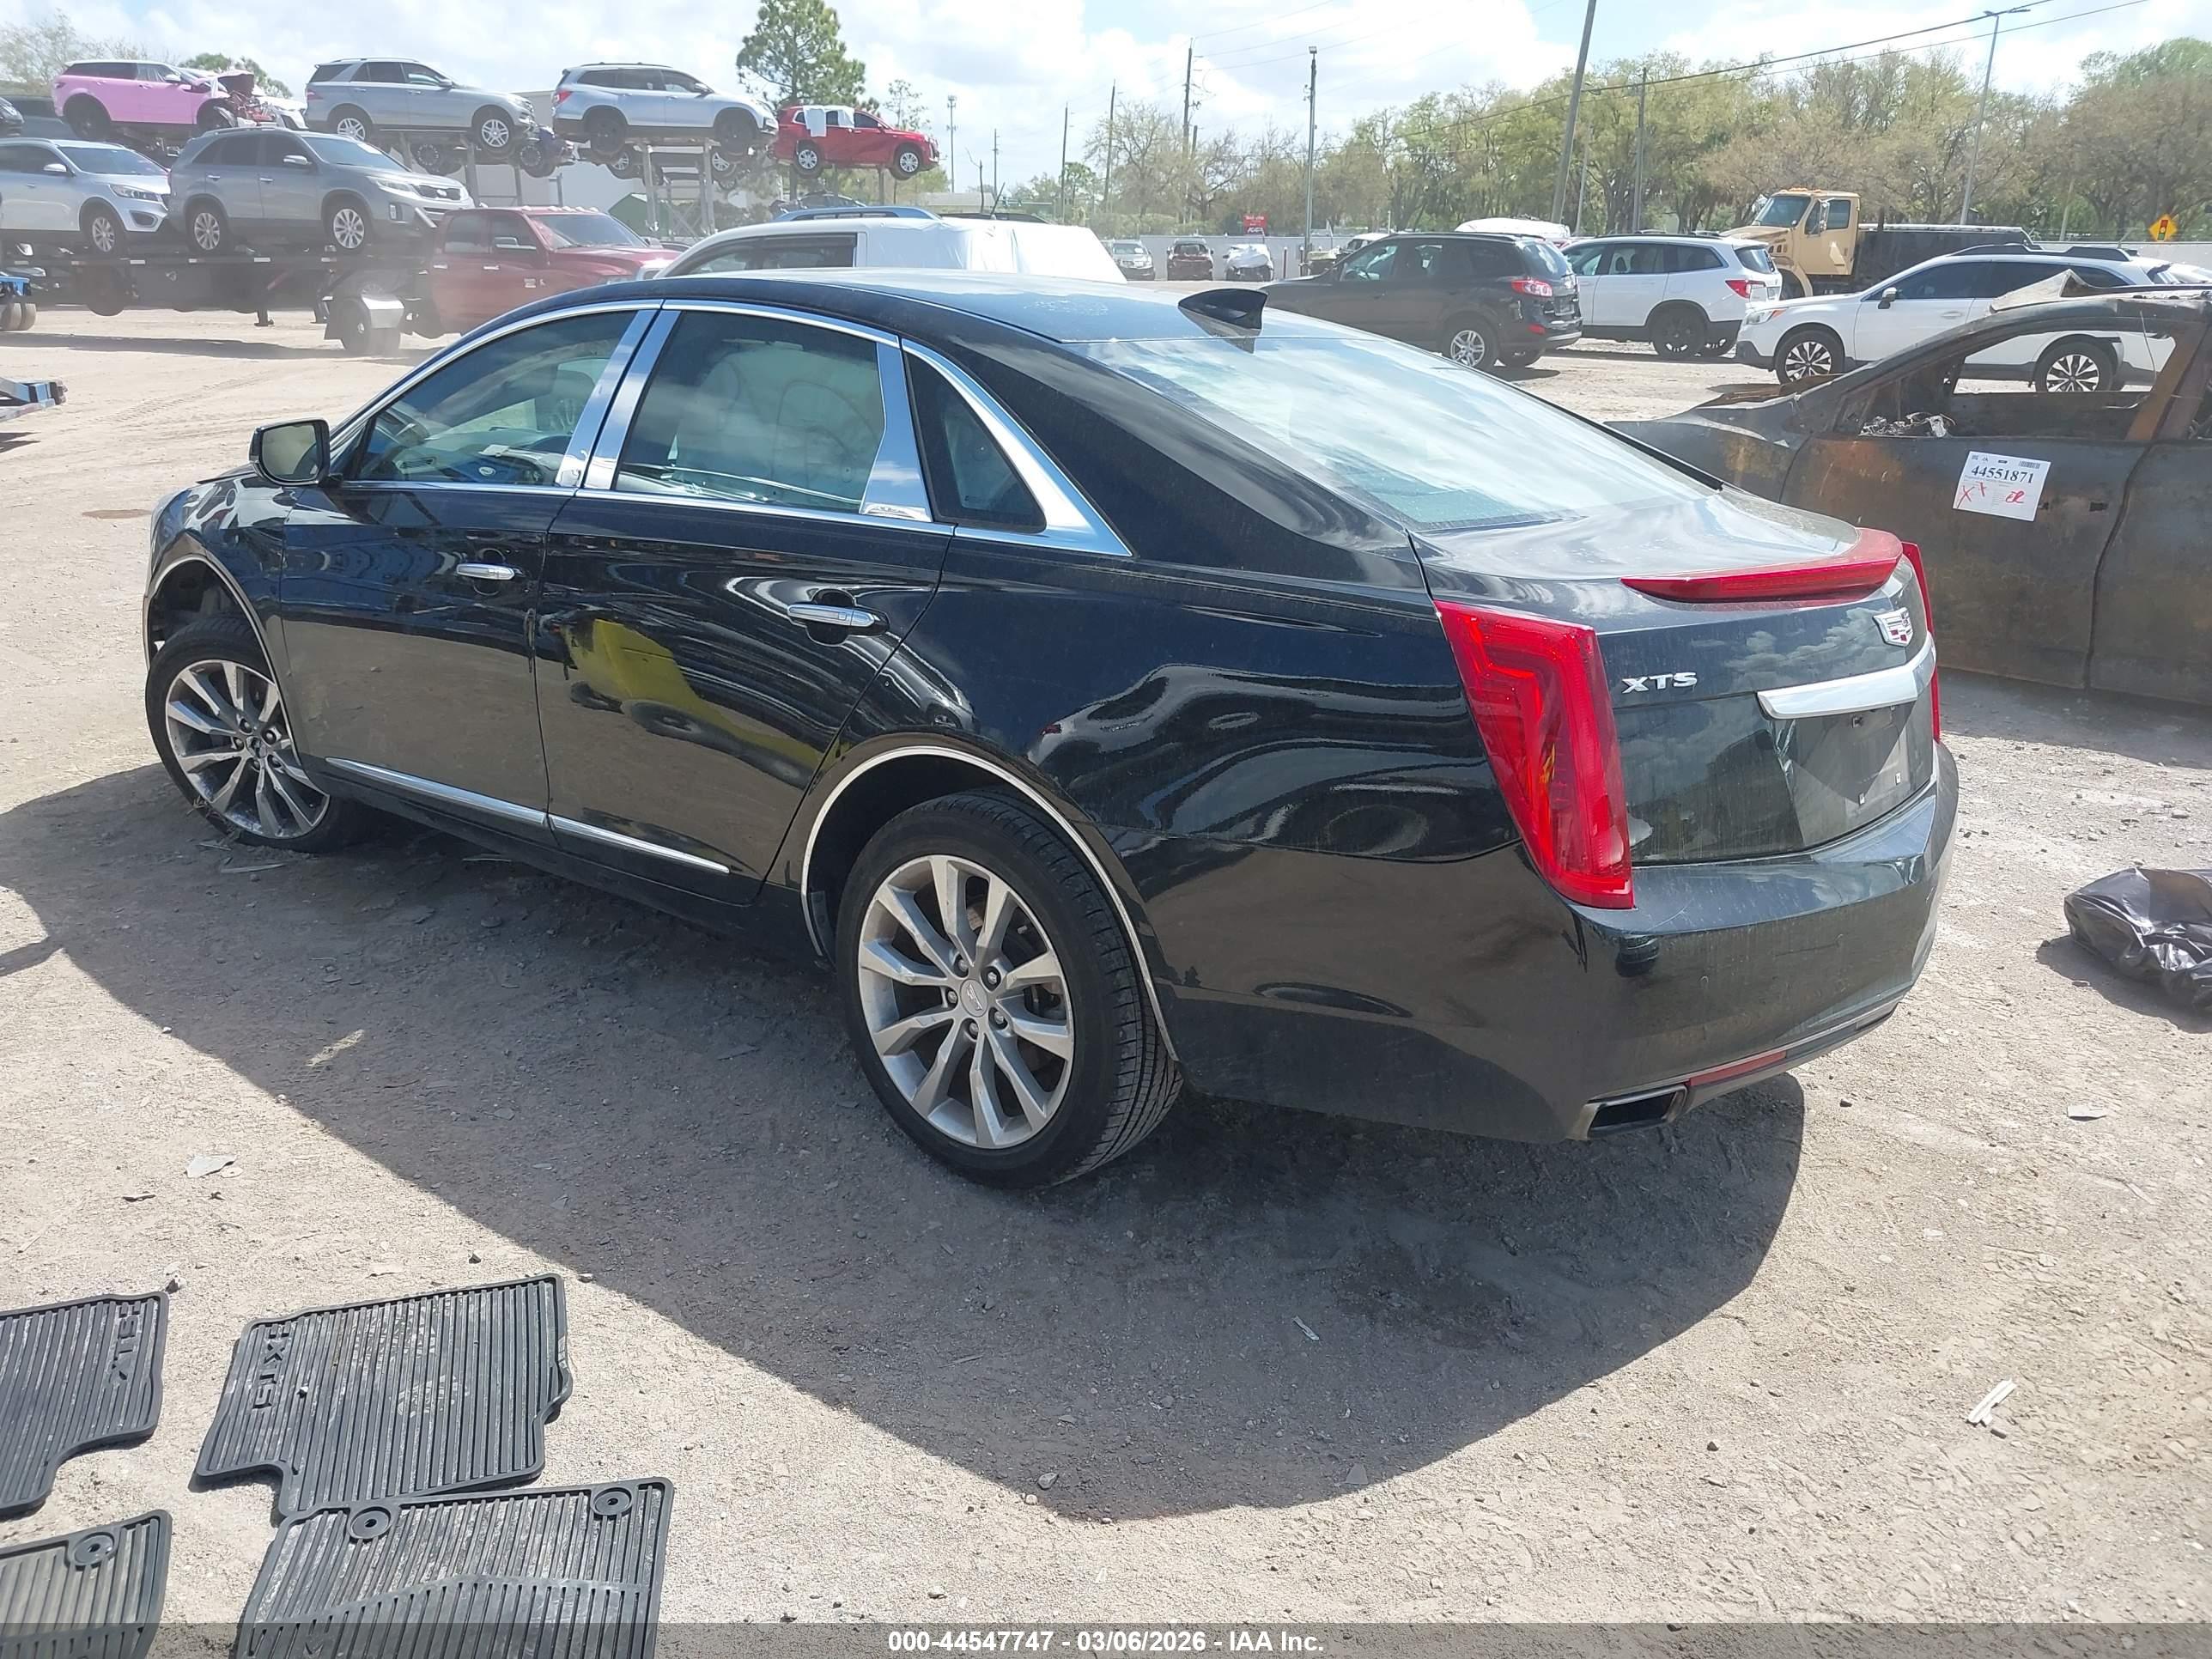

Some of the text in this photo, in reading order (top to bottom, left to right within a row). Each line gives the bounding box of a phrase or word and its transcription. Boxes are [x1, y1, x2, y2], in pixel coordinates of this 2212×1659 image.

[1971, 465, 2034, 483] 44551871
[1621, 672, 1698, 694] XTS
[252, 1338, 288, 1409] XTS
